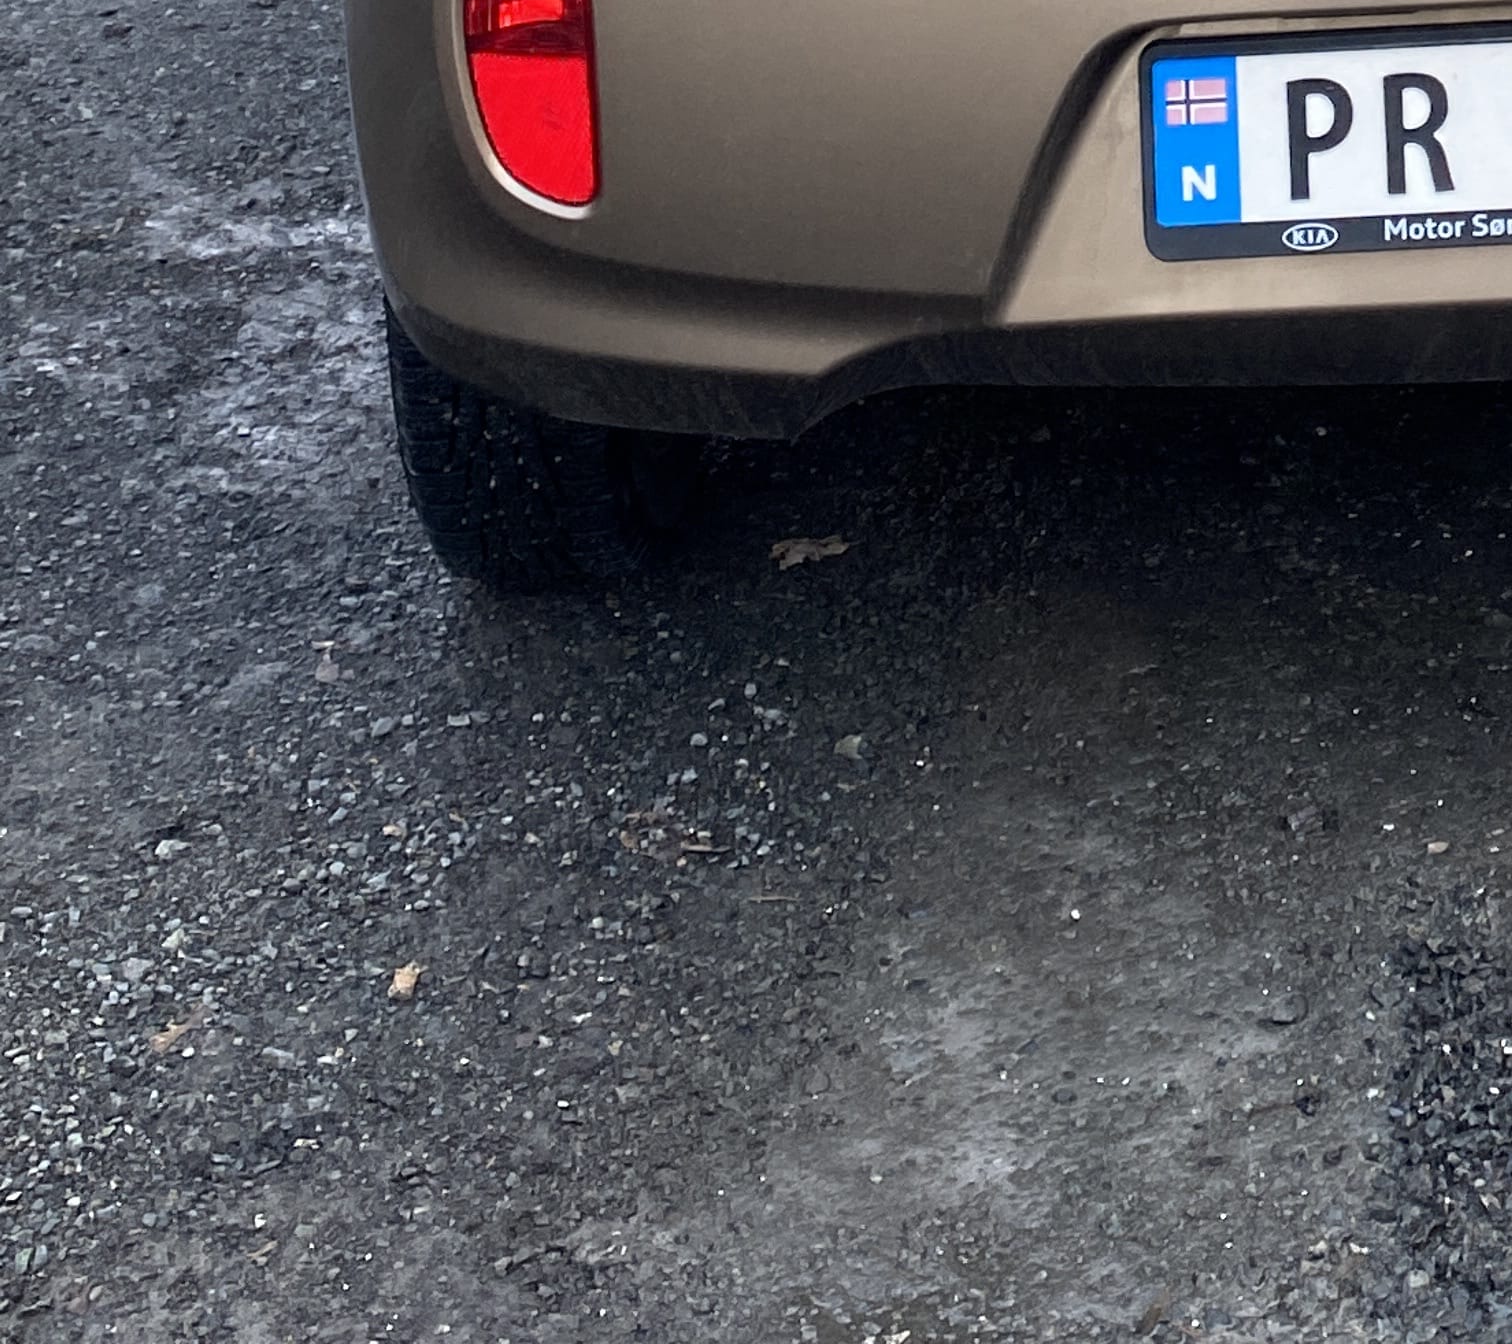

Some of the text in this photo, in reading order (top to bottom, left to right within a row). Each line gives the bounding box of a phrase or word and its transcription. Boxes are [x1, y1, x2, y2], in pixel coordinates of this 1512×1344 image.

[1286, 72, 1455, 200] PR
[1182, 164, 1217, 201] N
[1292, 229, 1330, 246] KIA
[1384, 218, 1466, 242] Motor
